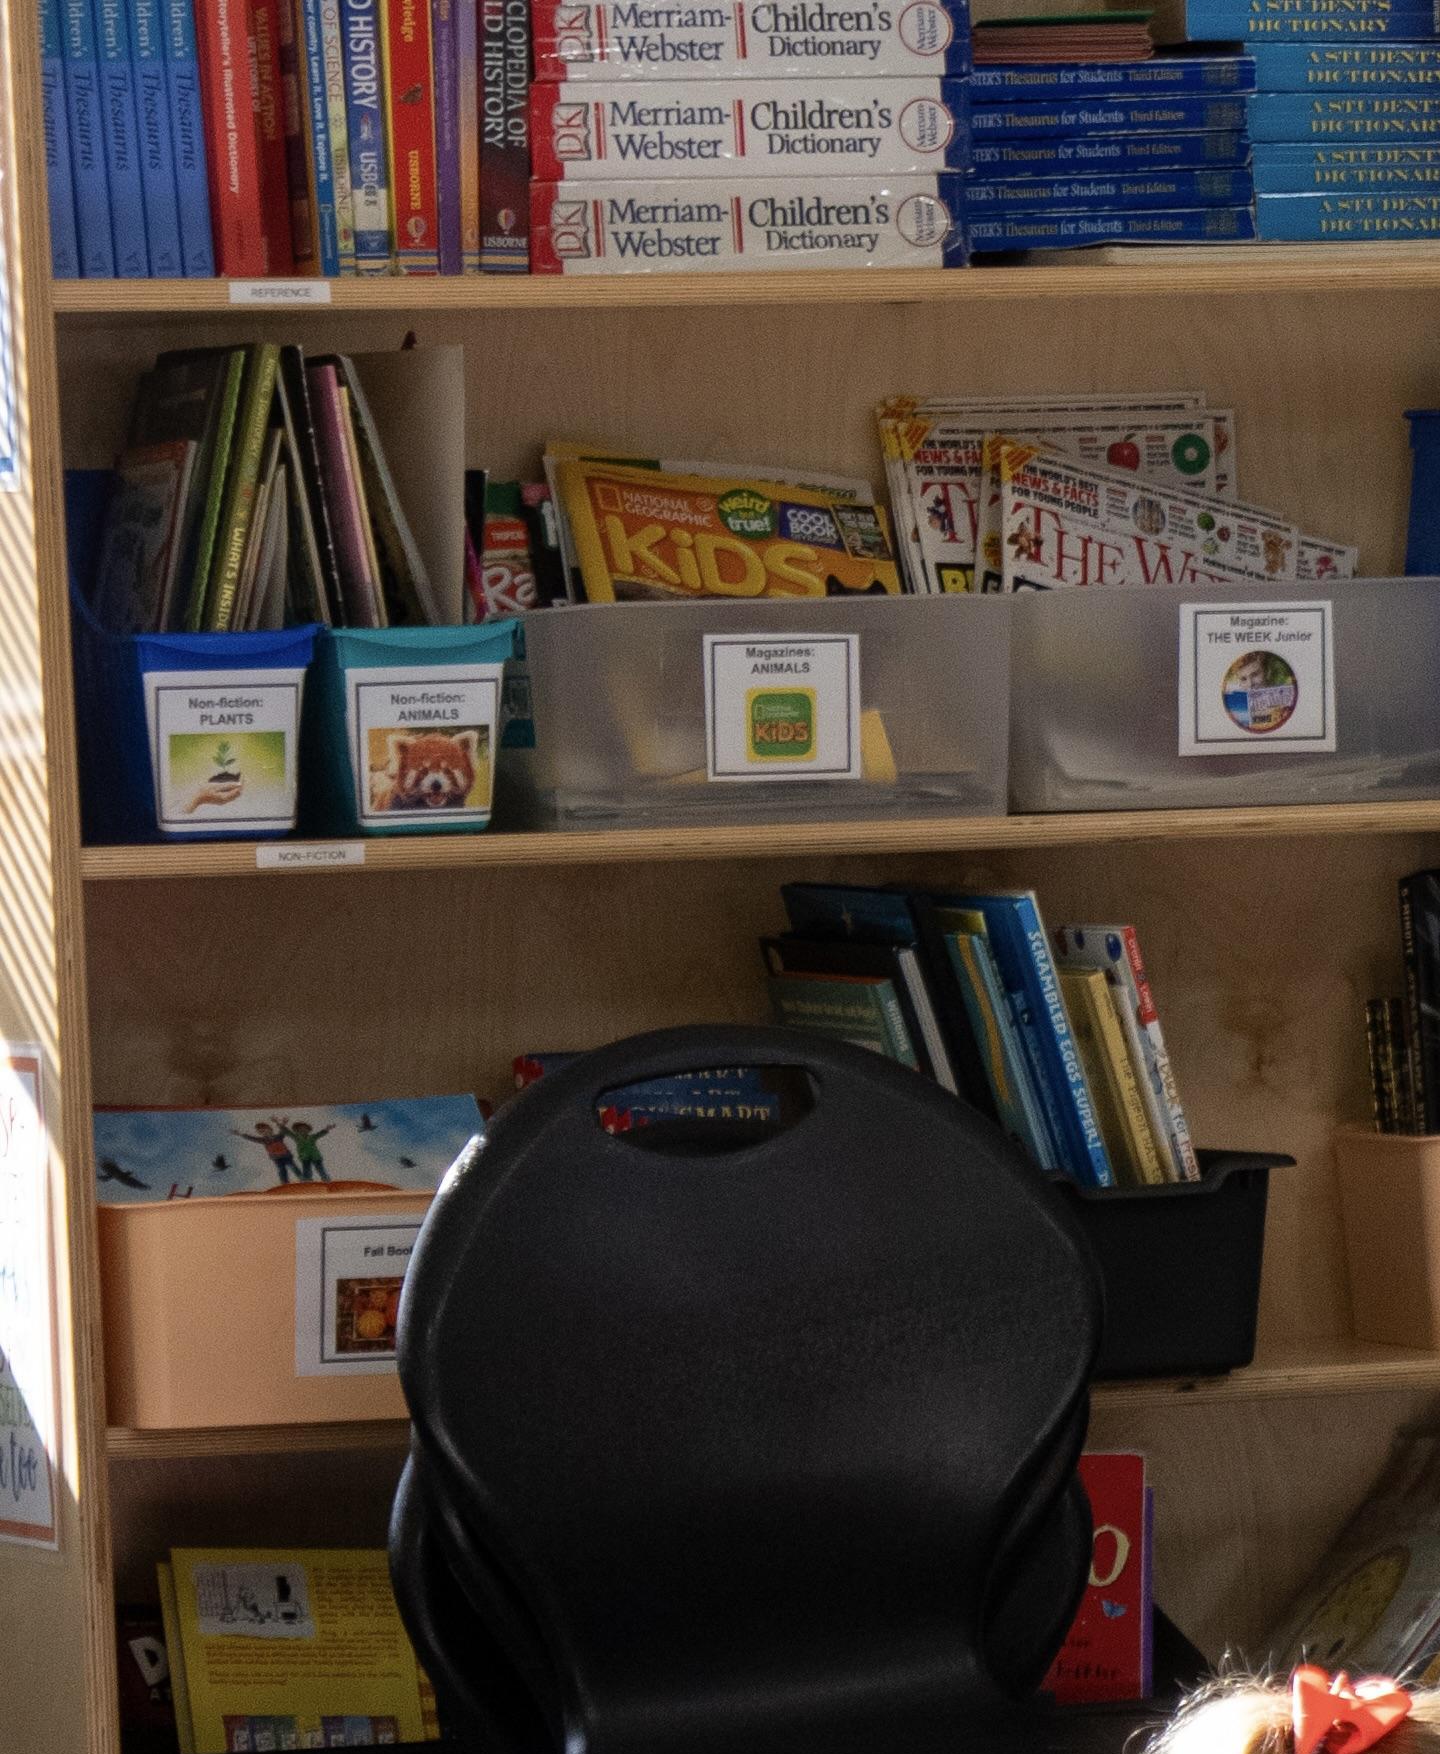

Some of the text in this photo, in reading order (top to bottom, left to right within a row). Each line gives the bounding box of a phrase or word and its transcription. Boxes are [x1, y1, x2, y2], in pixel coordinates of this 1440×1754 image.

[1266, 0, 1392, 12] STUDENT'S
[610, 2, 892, 34] Merriam- Children's
[1249, 20, 1390, 33] DICTIONARY
[556, 6, 585, 63] DK
[322, 7, 342, 102] OF SCIENCE
[616, 36, 882, 63] Webster Dictionary
[1306, 51, 1319, 64] A
[349, 16, 378, 109] HISTORY
[1004, 71, 1057, 85] Thesaurus
[1060, 71, 1073, 83] for
[1076, 70, 1123, 83] Students
[223, 68, 237, 129] Illustrated
[484, 41, 505, 148] HISTORY
[610, 99, 892, 132] Merriam- Children's
[1311, 100, 1323, 114] A
[73, 70, 95, 171] Thesaurus
[108, 72, 130, 172] Thesaurus
[141, 70, 163, 171] Thesaurus
[175, 70, 197, 171] Thesaurus
[1004, 112, 1058, 127] Thesaurus
[1060, 111, 1075, 125] for
[1079, 110, 1124, 125] Students
[508, 119, 528, 148] OF
[556, 105, 585, 159] DK
[614, 133, 882, 161] Webster Dictionary
[1002, 147, 1056, 161] Thesaurus
[1058, 146, 1072, 159] for
[1076, 145, 1121, 158] Students
[1314, 151, 1326, 164] A
[227, 131, 240, 194] Dictionary
[408, 150, 421, 210] USBORNE
[997, 185, 1051, 199] Thesaurus
[1053, 183, 1066, 197] for
[1069, 182, 1116, 196] Students
[608, 196, 890, 228] Merriam- Children's
[1319, 200, 1331, 213] A
[555, 203, 584, 256] DK
[1005, 222, 1057, 236] Thesaurus
[1060, 221, 1073, 234] for
[1076, 220, 1123, 233] Students
[483, 236, 527, 248] USBORNE
[612, 229, 880, 258] Webster Dictionary
[250, 287, 311, 298] REFERENCE
[914, 450, 951, 464] NEWS
[916, 466, 935, 477] FOR
[1039, 467, 1077, 484] WORLD'S
[1079, 478, 1099, 493] BEST
[622, 490, 690, 511] NATIONAL
[1012, 473, 1050, 493] NEWS
[1063, 486, 1099, 507] FACTS
[718, 489, 770, 515] weird
[1012, 487, 1031, 498] FOR
[1033, 490, 1063, 508] YOUNG
[1064, 500, 1099, 518] PEOPLE
[623, 502, 713, 529] GEOGRAPHIC
[728, 515, 771, 532] true!
[1229, 615, 1289, 630] Magazine:
[1207, 630, 1312, 644] THE WEEK Junior
[745, 647, 815, 661] Magazines:
[751, 662, 810, 675] ANIMALS
[188, 696, 264, 710] Non-fiction:
[390, 692, 466, 706] Non-fiction:
[200, 712, 254, 726] PLANTS
[398, 707, 460, 721] ANIMALS
[278, 849, 346, 862] NON-FICTION
[1028, 930, 1101, 1150] SCRAMBLED EGGS SUPER!
[364, 1247, 384, 1257] Fall
